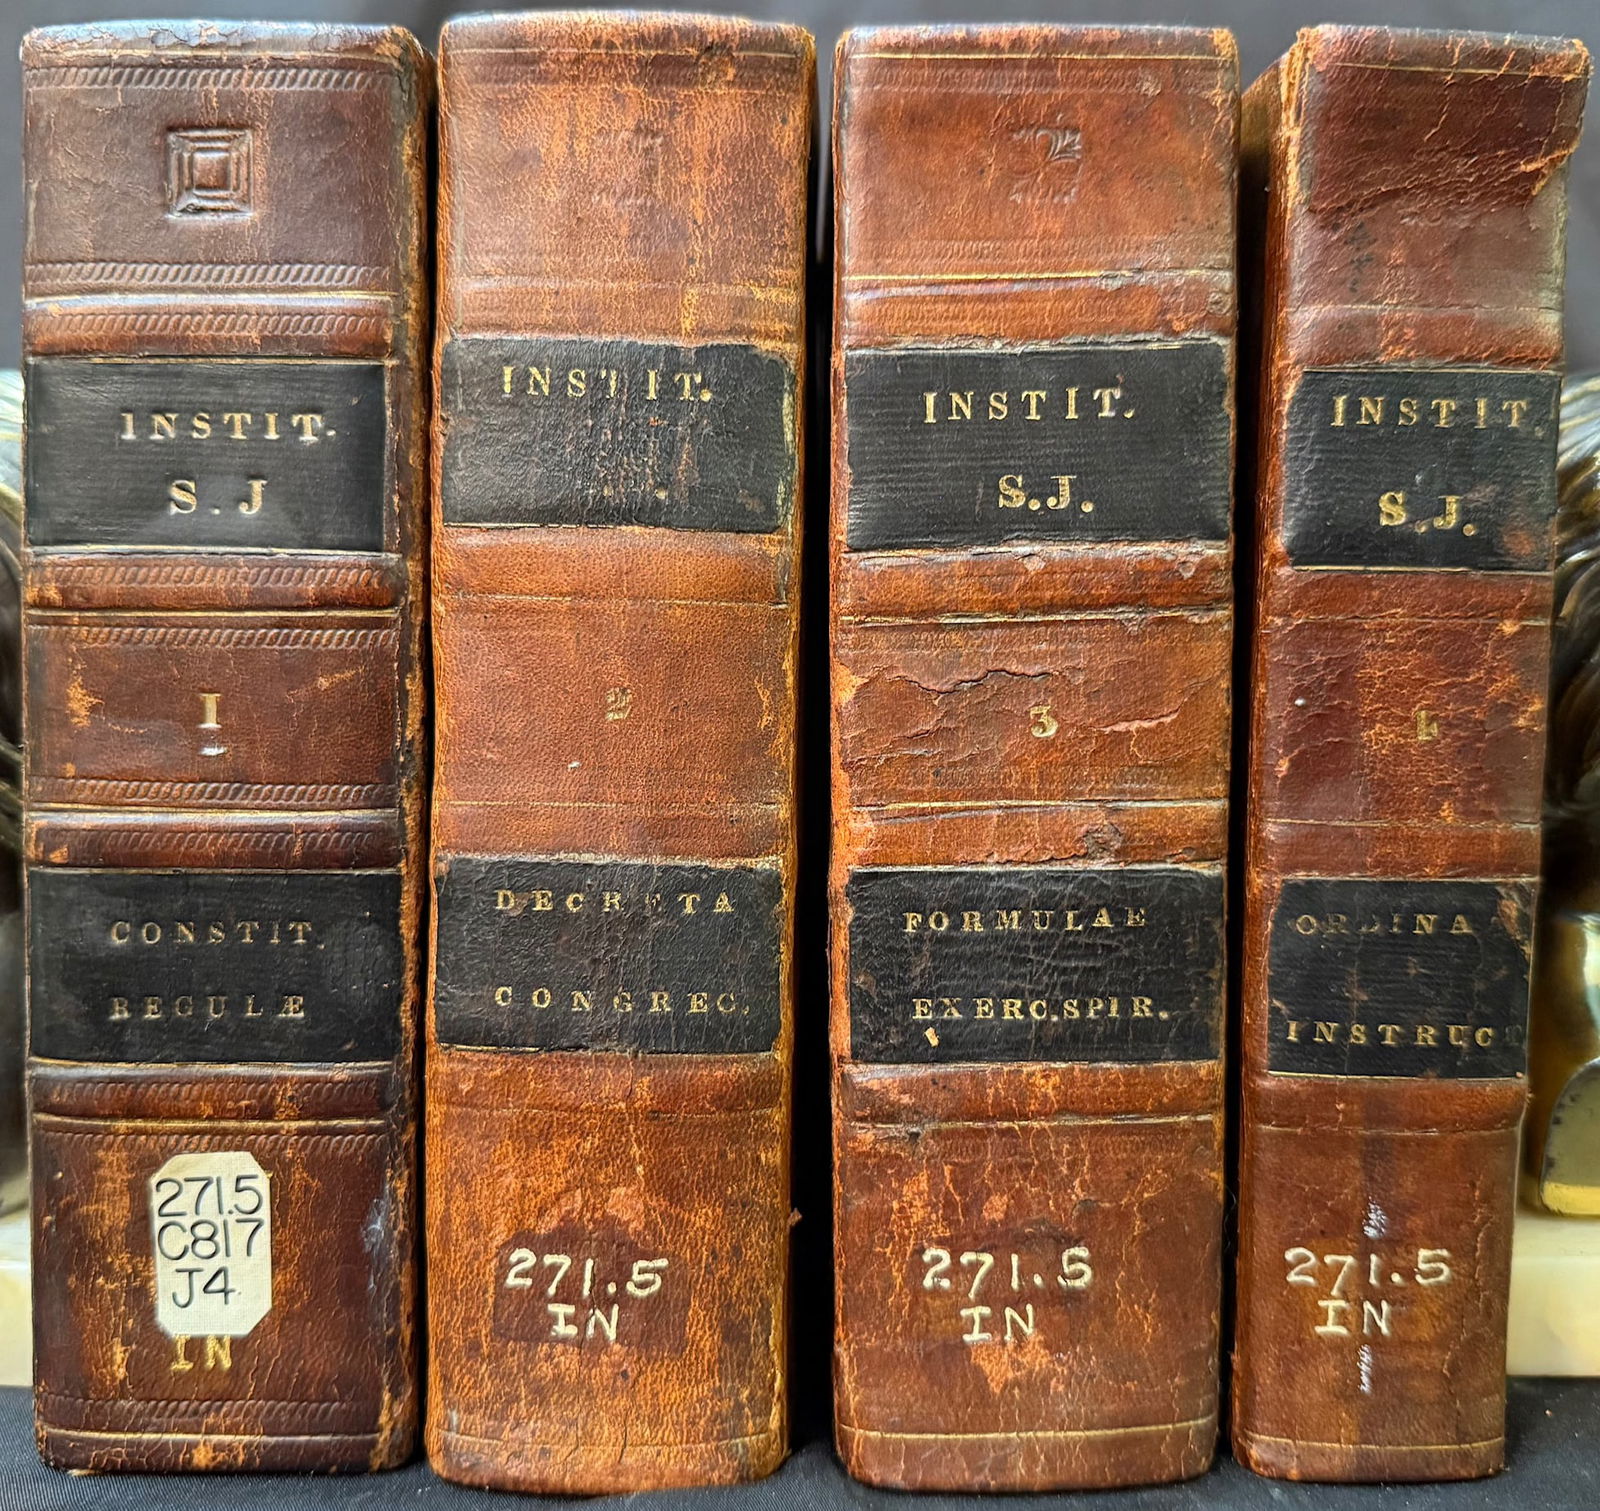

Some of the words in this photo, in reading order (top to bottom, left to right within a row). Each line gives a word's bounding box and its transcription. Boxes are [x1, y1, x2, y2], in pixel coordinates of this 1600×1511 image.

[923, 387, 1136, 424] INSTIT.
[119, 412, 337, 442] INSTIT.
[998, 474, 1094, 513] S.J.
[1378, 491, 1478, 537] S.J.
[1030, 705, 1059, 738] 3
[110, 921, 326, 950] CONSTIT.
[902, 906, 1147, 933] FORMULAE
[156, 1173, 264, 1218] 271.5
[157, 1217, 265, 1261] C817
[172, 1265, 236, 1309] J4
[506, 1247, 670, 1296] 271.5
[922, 1247, 1093, 1299] 271.5
[1284, 1246, 1451, 1296] 271.5
[547, 1303, 619, 1341] IN
[960, 1302, 1035, 1342] IN
[1314, 1299, 1391, 1337] IN
[171, 1334, 232, 1371] IN
